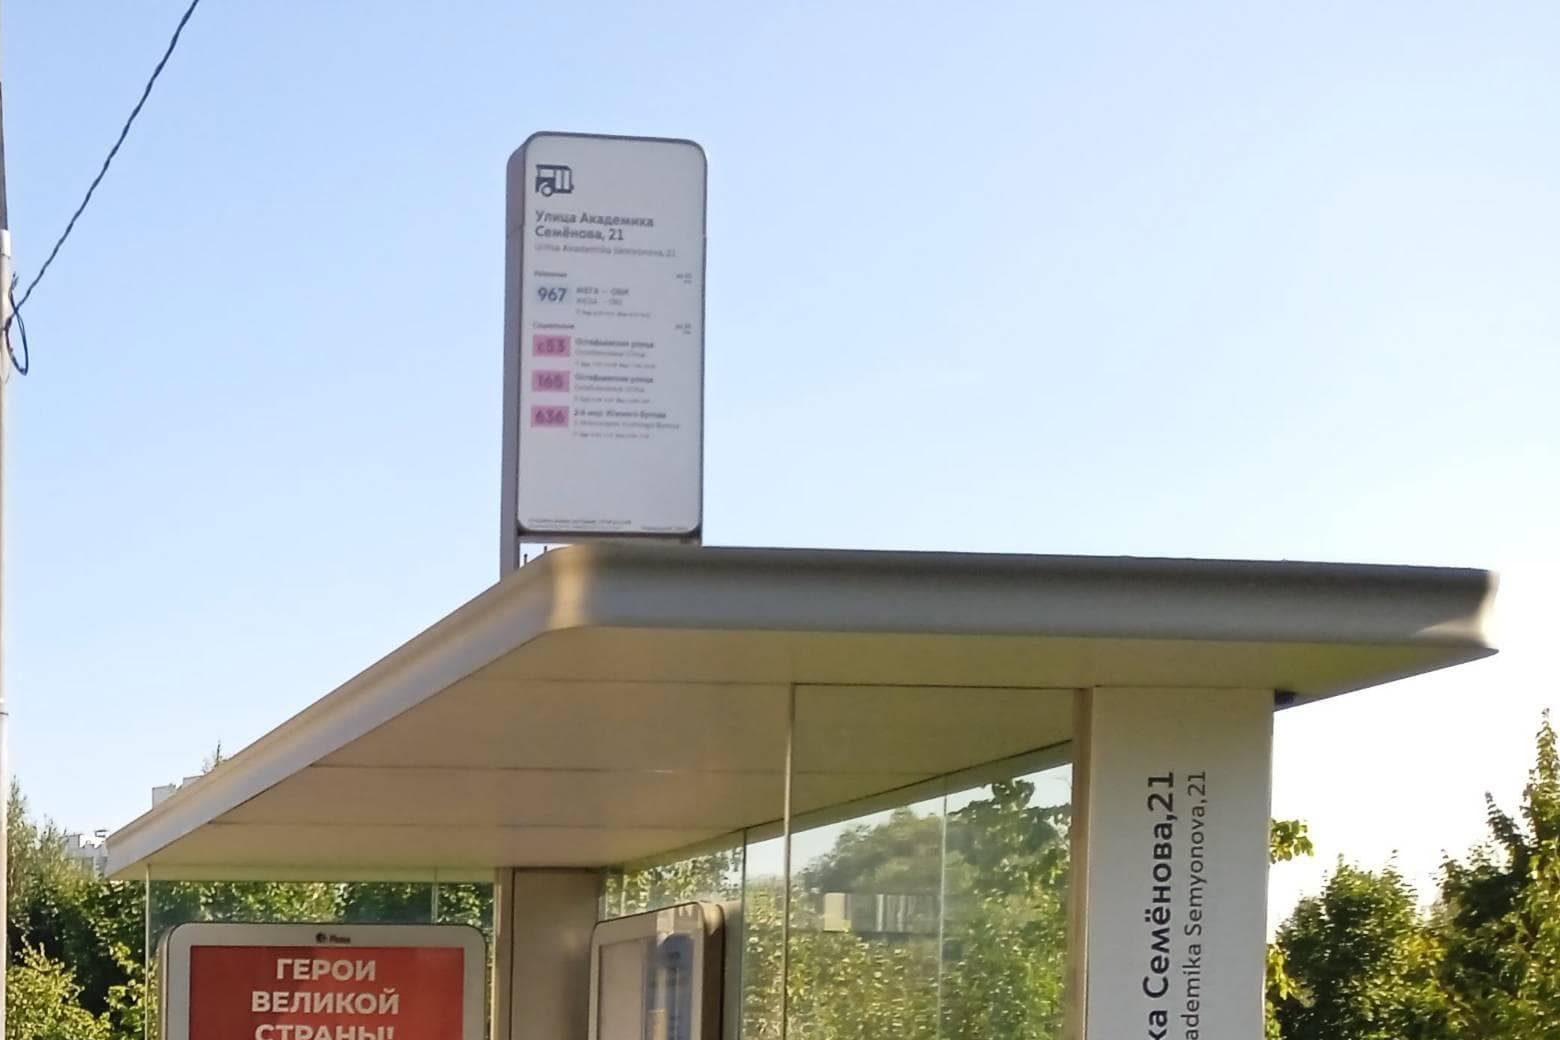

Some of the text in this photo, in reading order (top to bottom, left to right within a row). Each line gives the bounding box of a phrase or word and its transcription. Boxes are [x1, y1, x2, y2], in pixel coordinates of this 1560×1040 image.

[535, 210, 654, 228] Улица Академика
[535, 225, 624, 241] Семёнова, 21
[537, 287, 567, 302] 967
[276, 958, 376, 982] ГЕРОИ
[251, 988, 400, 1015] ВЕЛИКОЙ
